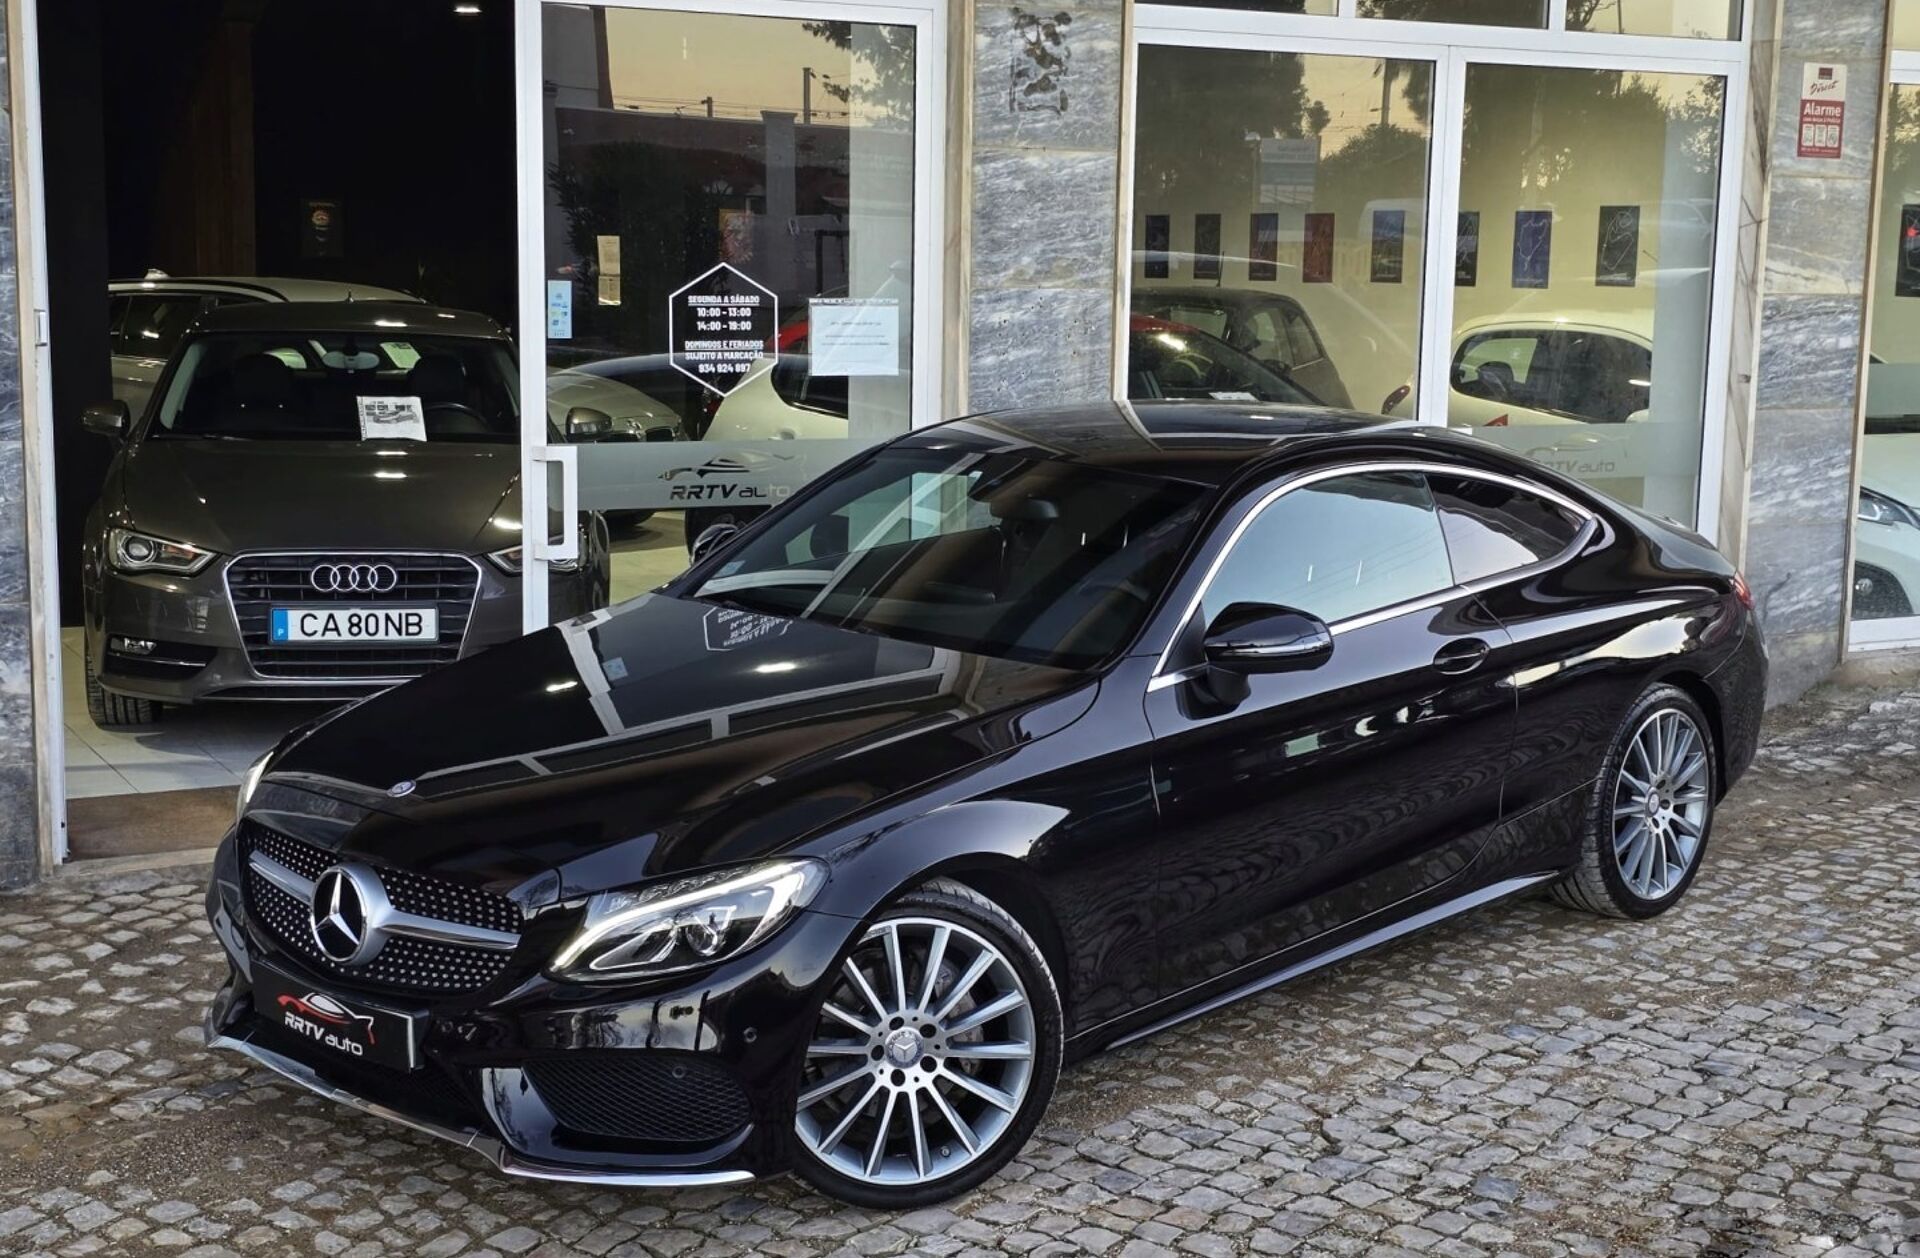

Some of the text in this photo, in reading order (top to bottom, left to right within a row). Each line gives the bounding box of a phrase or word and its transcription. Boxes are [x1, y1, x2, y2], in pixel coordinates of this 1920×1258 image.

[1803, 101, 1842, 117] Alarme
[688, 295, 721, 304] SEGUNDA
[730, 294, 760, 304] SÁBADO
[696, 307, 721, 317] 10:00
[728, 307, 751, 317] 13:00
[696, 321, 721, 331] 14:00
[728, 321, 752, 331] 19:00
[685, 340, 721, 349] DOMINGOS
[729, 340, 764, 349] FERIADOS
[685, 351, 715, 360] SUJEITO
[724, 350, 764, 361] MARCAÇÃO
[670, 484, 790, 500] RRTV auto
[300, 613, 423, 637] CA 80 NB
[277, 628, 285, 636] P
[284, 1011, 364, 1056] RRTV auto
